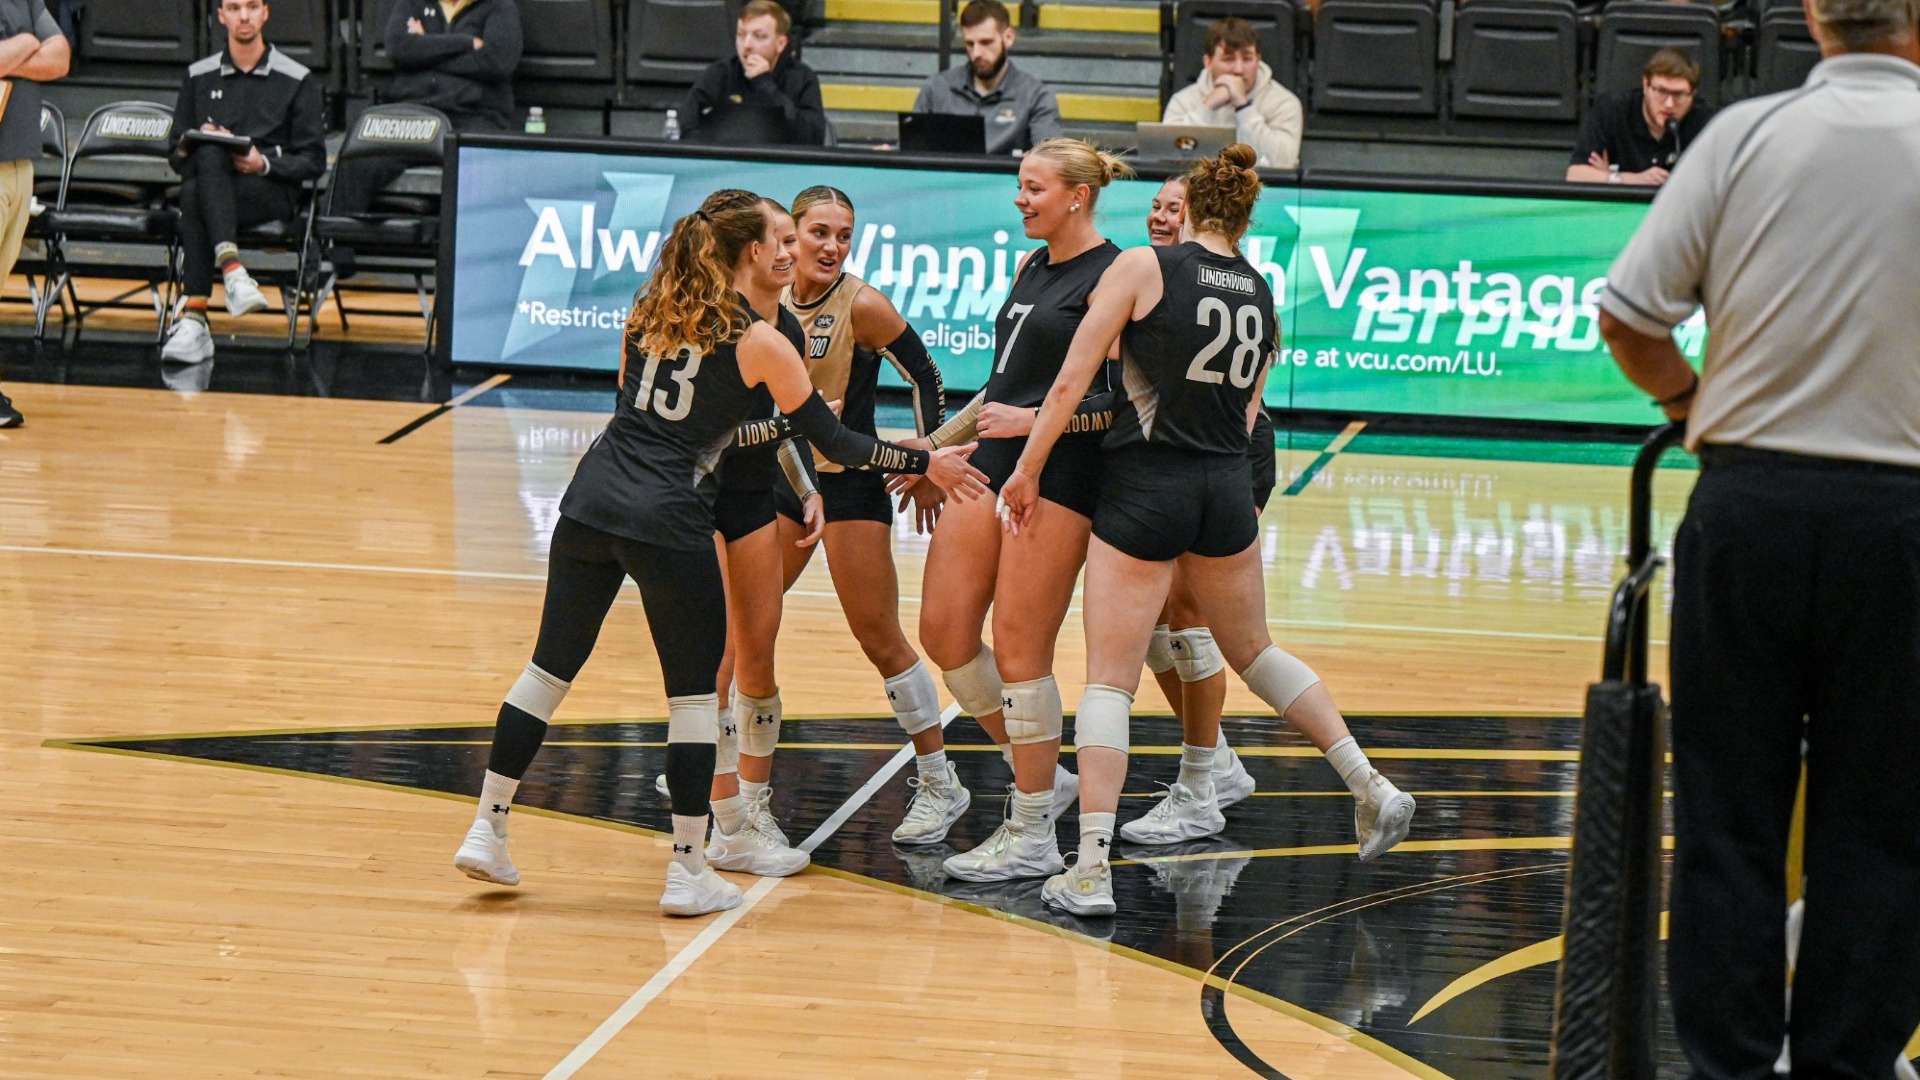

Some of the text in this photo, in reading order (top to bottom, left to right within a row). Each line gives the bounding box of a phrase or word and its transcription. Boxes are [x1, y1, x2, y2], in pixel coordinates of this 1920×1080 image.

[101, 115, 171, 137] LINDENWOOD
[362, 117, 437, 140] LINDENWOOD
[518, 203, 671, 273] Alw
[842, 222, 1026, 292] inni
[1200, 266, 1255, 293] LINDENWOOD
[996, 302, 1035, 374] 7
[1185, 296, 1264, 389] 28
[1315, 347, 1340, 368] at
[1345, 348, 1503, 377] vcu.com/LU.
[634, 339, 704, 422] 13
[738, 419, 778, 447] LIONS
[870, 443, 908, 470] LIONS
